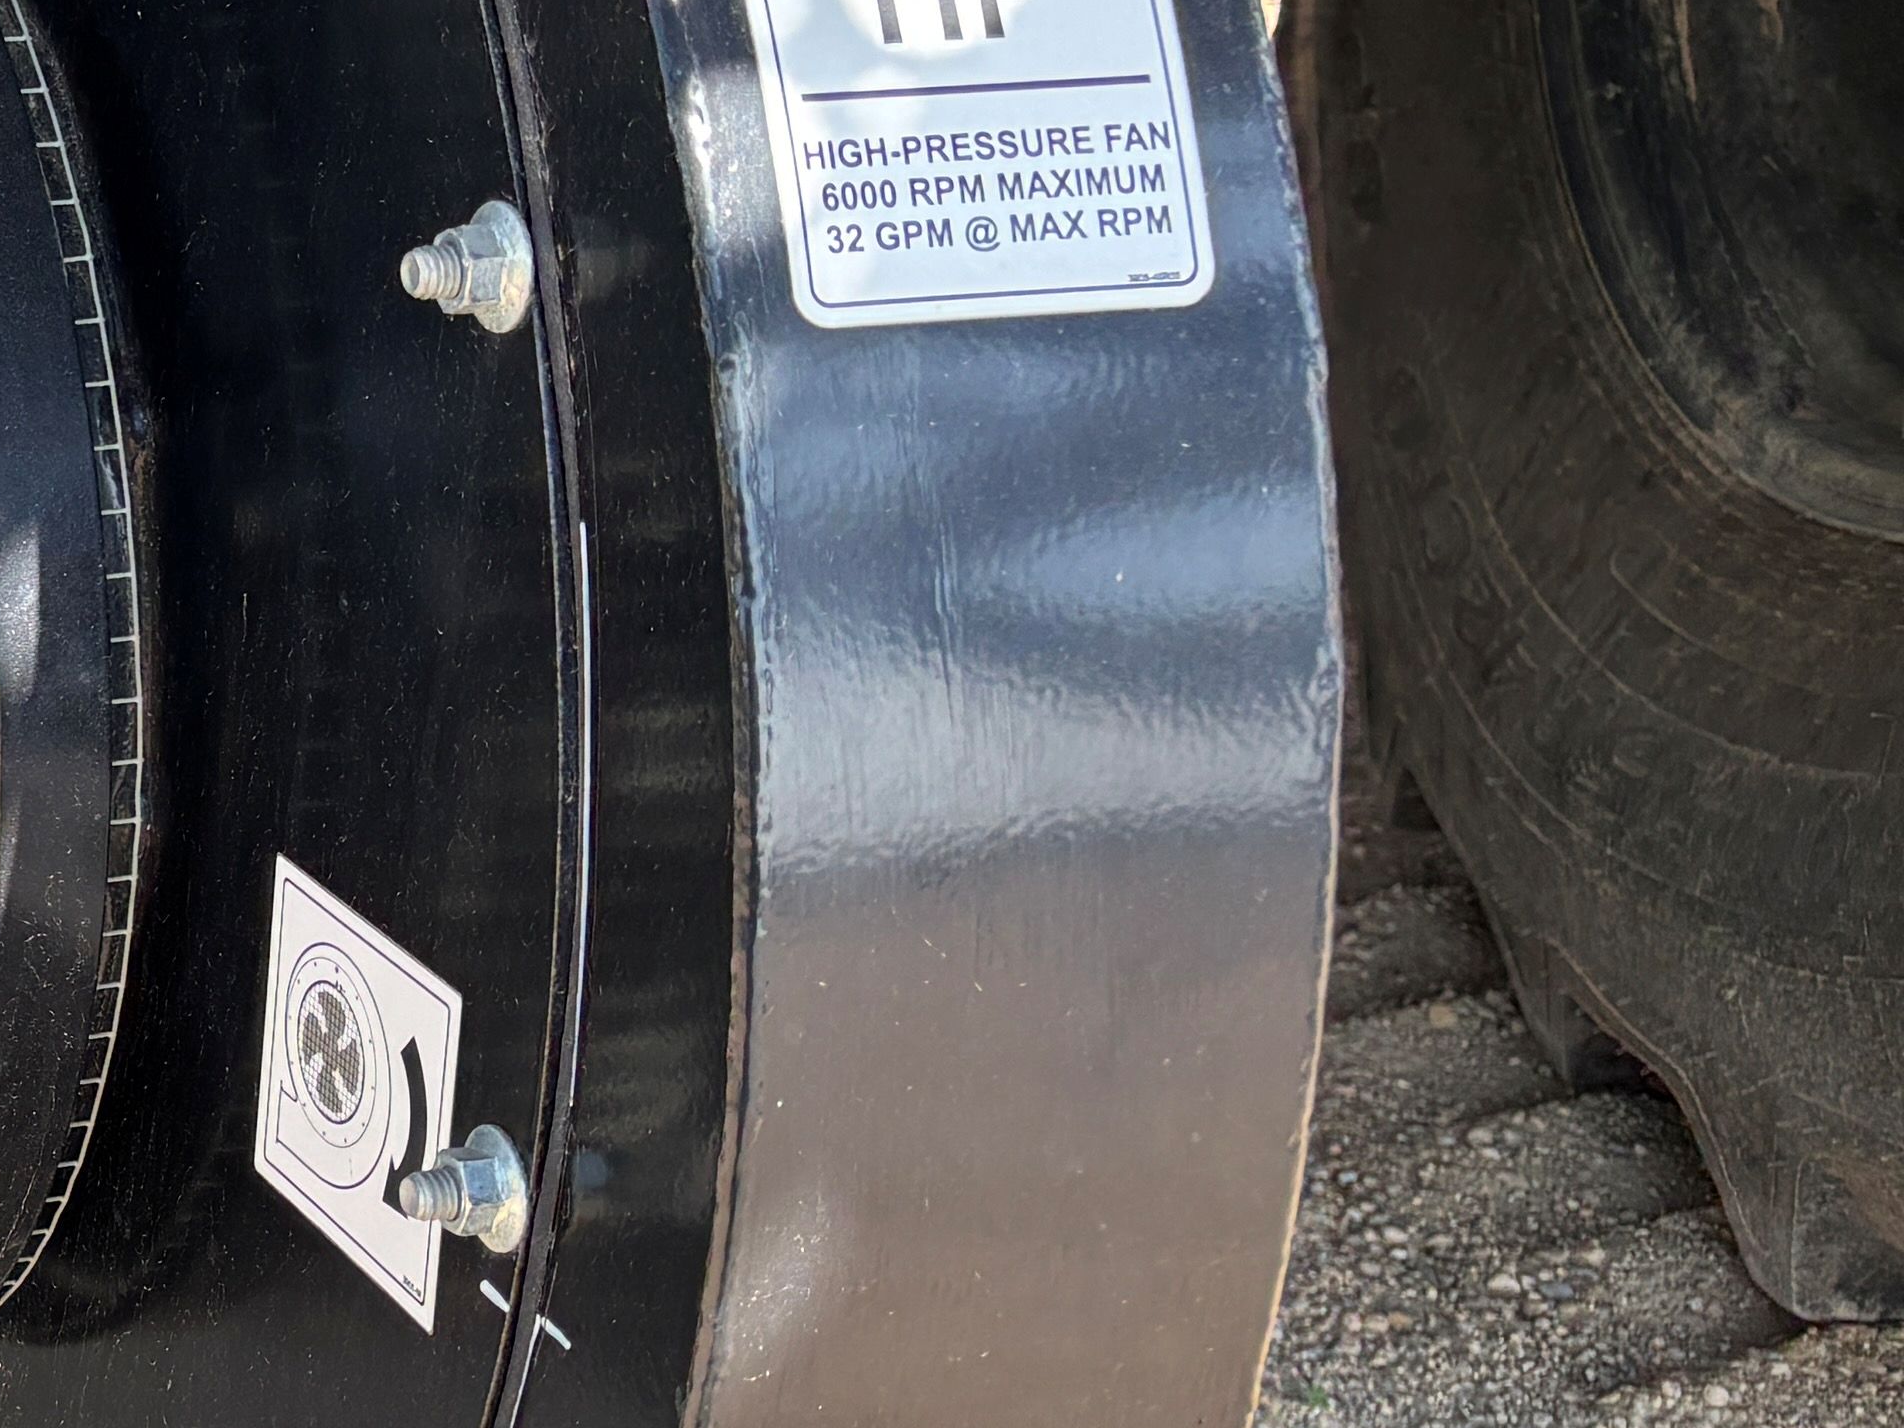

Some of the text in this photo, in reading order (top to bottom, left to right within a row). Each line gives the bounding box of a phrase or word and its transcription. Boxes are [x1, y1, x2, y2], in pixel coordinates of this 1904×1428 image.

[803, 121, 1171, 170] HIGH-PRESSURE FAN
[821, 164, 1166, 211] 6000 RPM MAXIMUM
[827, 205, 1172, 253] 32 GPM @ MAX RPM
